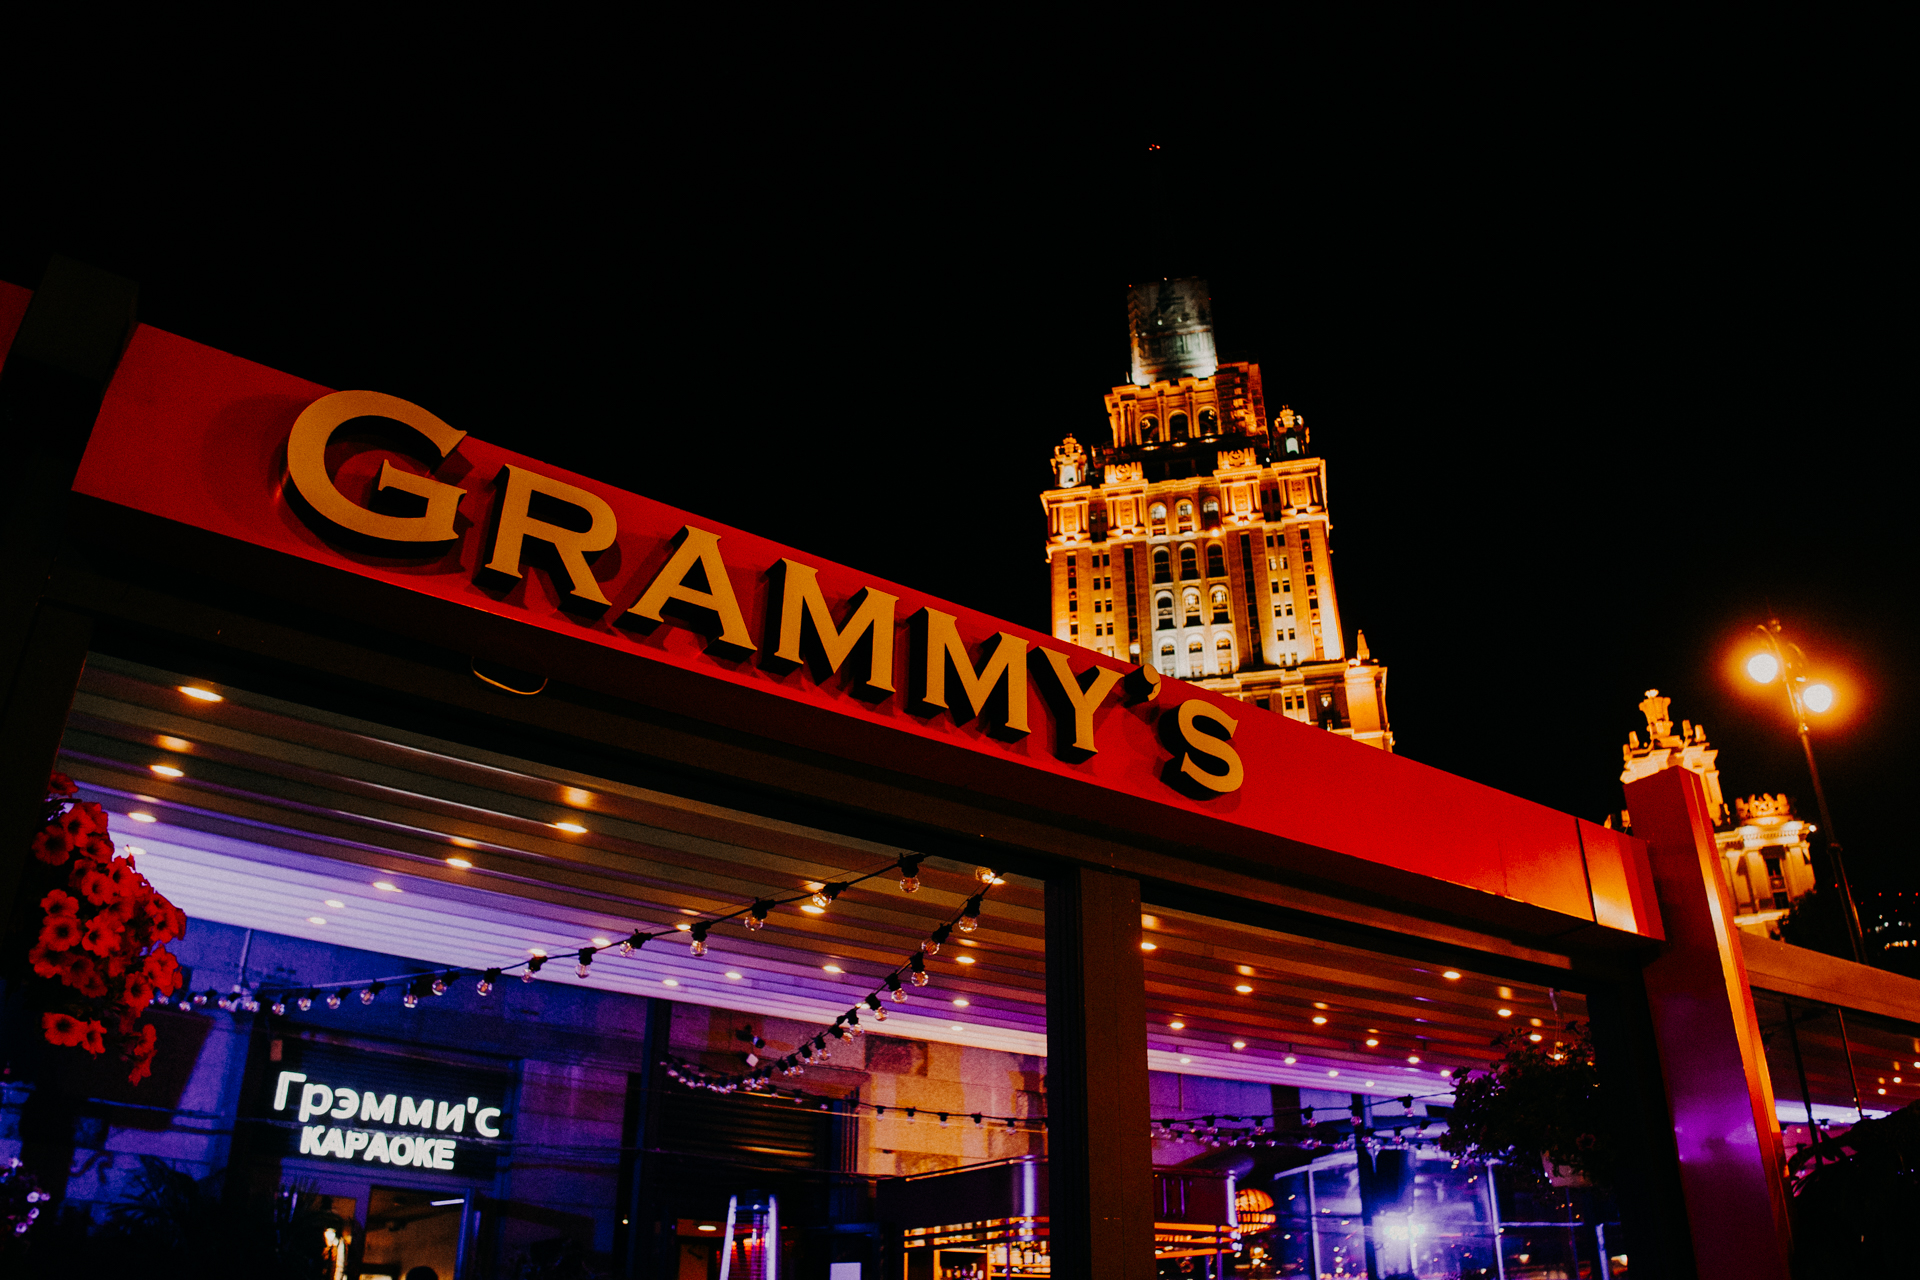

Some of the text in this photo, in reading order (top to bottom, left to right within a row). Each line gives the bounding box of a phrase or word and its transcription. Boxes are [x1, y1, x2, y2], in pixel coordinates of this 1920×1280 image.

[286, 390, 1244, 794] GRAMMY'S
[273, 1071, 501, 1138] Грэмми'с
[300, 1126, 457, 1171] КАРАОКЕ
